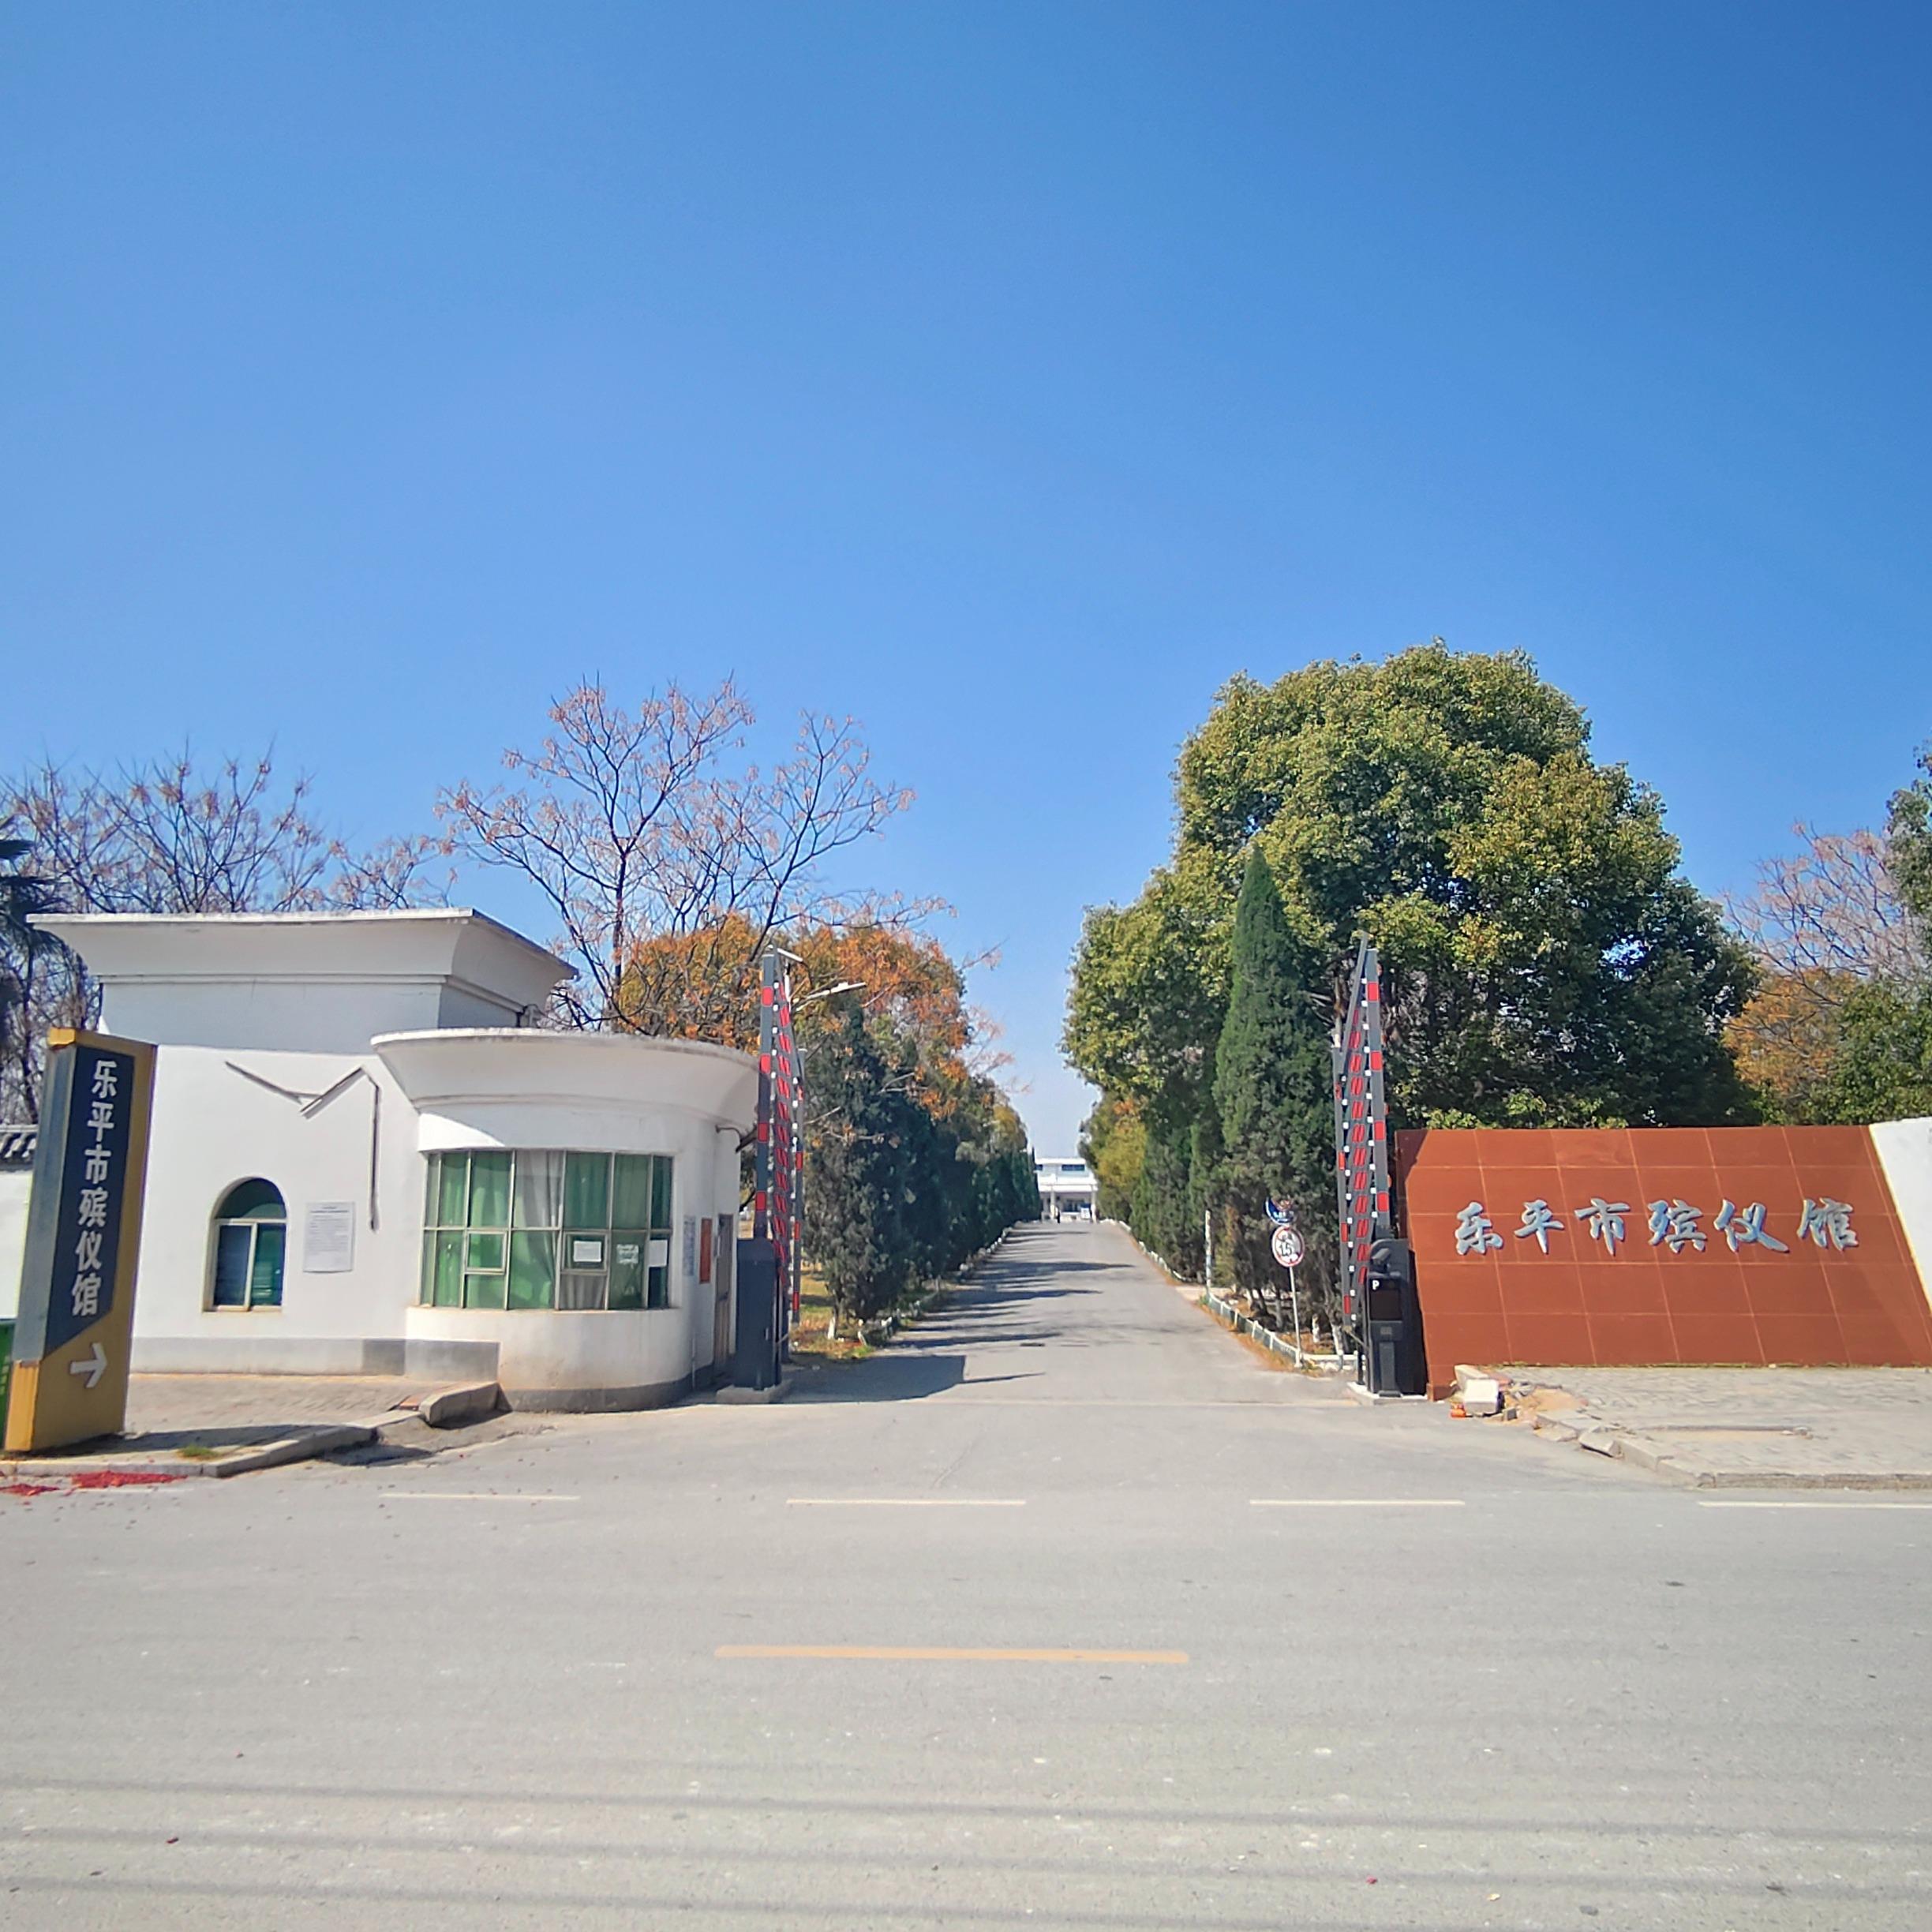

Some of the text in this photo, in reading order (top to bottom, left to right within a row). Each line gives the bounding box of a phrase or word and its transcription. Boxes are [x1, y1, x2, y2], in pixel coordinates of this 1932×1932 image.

[72, 1060, 118, 1316] 乐平市殡仪馆
[1455, 1198, 1859, 1256] 乐平市殡仪馆
[1372, 1279, 1380, 1290] P
